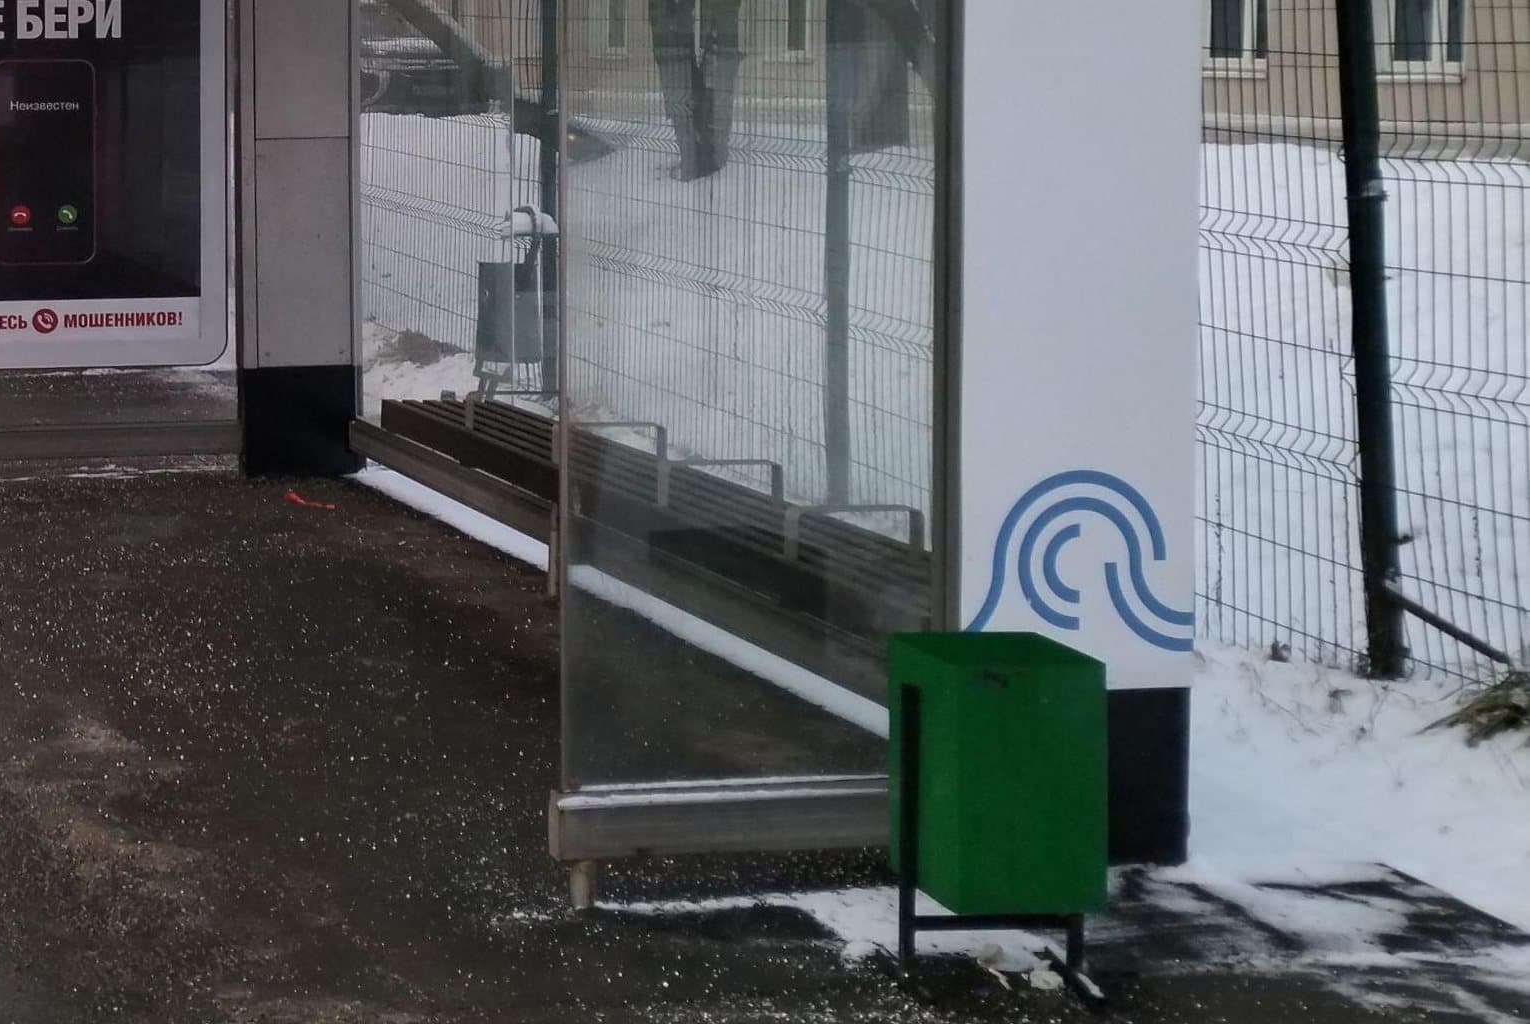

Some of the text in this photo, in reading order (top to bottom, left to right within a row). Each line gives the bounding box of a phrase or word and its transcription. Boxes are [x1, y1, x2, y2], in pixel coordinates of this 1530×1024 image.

[17, 0, 122, 39] БЕРИ
[10, 100, 79, 111] Неизвестен
[64, 311, 183, 328] МОШЕННИКОВ!
